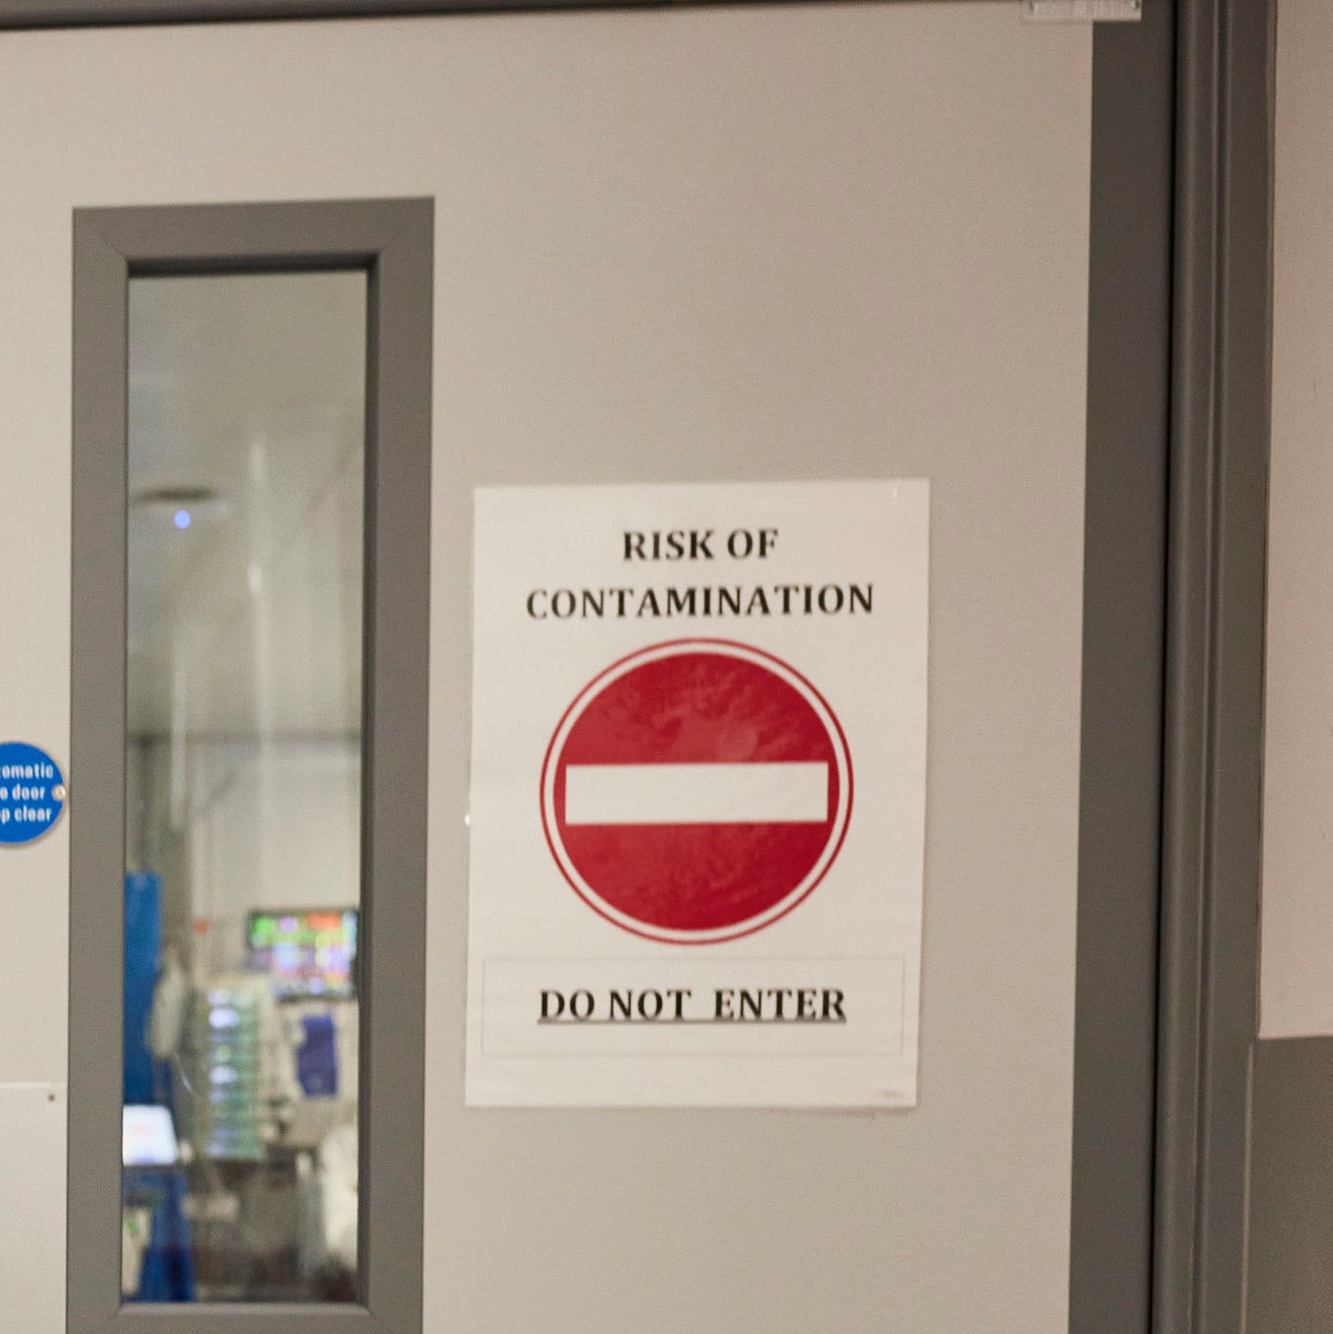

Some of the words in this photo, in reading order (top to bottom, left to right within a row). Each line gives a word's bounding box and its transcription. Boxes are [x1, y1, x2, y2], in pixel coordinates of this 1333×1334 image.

[622, 530, 715, 561] RISK
[725, 529, 780, 560] OF
[525, 583, 876, 620] CONTAMINATION
[12, 783, 45, 800] door
[14, 805, 51, 822] clear
[539, 989, 594, 1020] DO
[609, 988, 693, 1020] NOT
[714, 988, 847, 1020] ENTER
